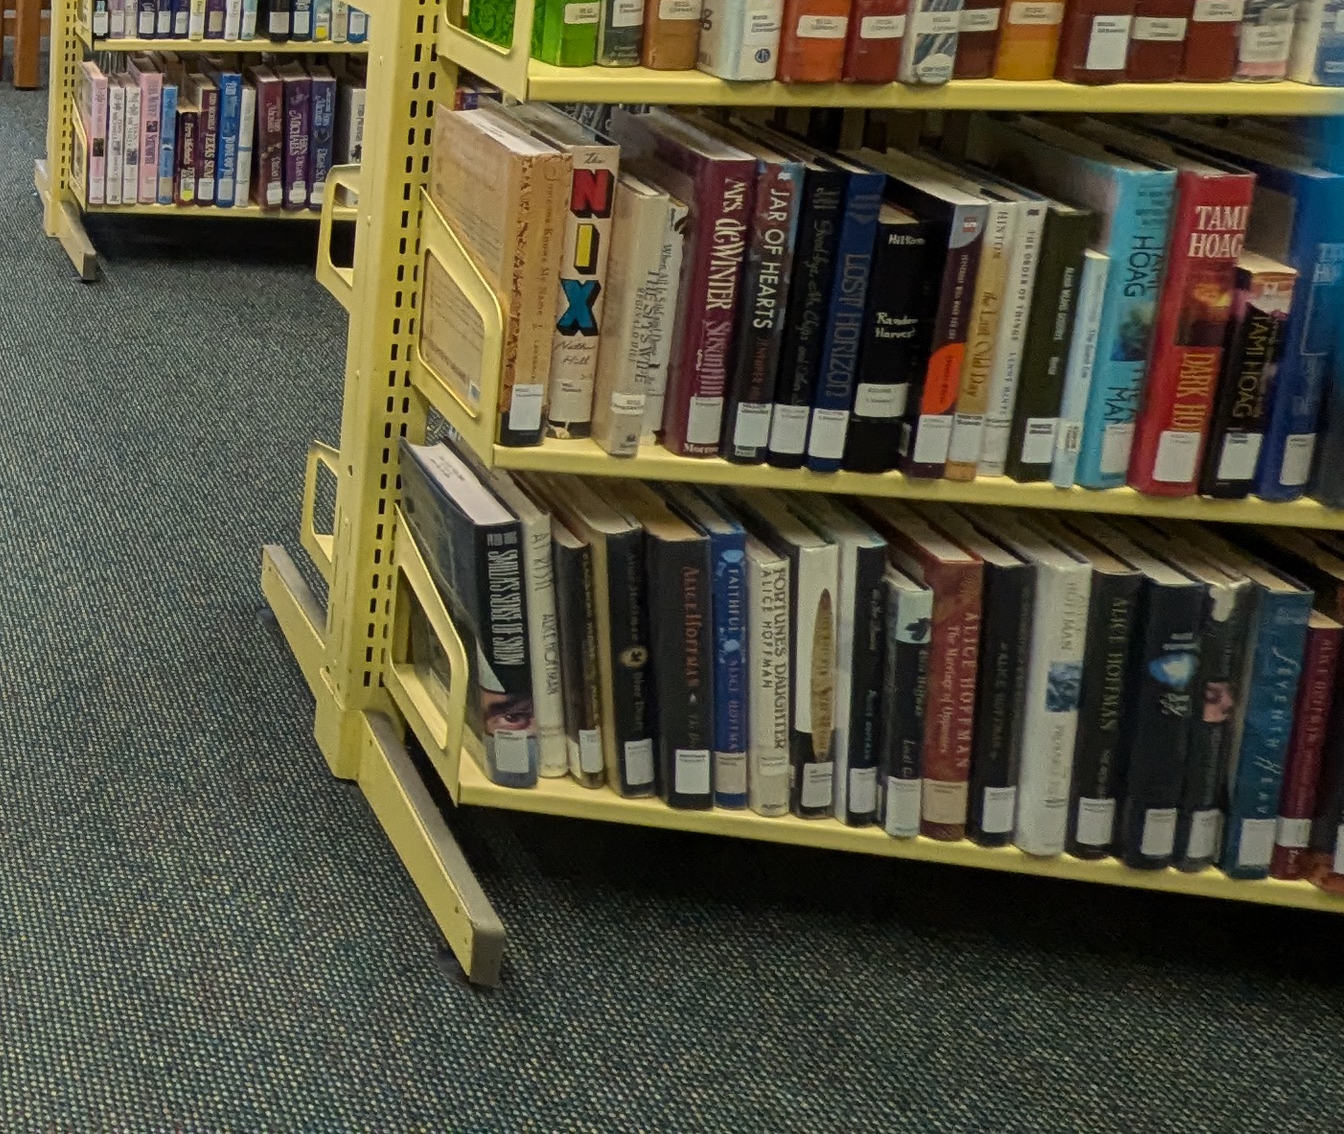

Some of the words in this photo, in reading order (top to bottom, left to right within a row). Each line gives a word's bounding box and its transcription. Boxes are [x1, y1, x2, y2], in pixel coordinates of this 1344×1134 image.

[584, 153, 604, 164] The
[767, 188, 790, 221] JAR
[1194, 206, 1248, 230] TAMI
[557, 169, 614, 337] NIX
[763, 229, 785, 256] OF
[888, 234, 925, 246] Hilton
[1188, 233, 1242, 257] HOAG
[839, 254, 870, 308] LOST
[1124, 236, 1154, 298] HOAG
[753, 262, 779, 328] HEARTS
[875, 313, 918, 326] Random
[1245, 316, 1270, 355] TAMI
[563, 356, 590, 365] Hill
[826, 312, 860, 398] HORIZON
[1175, 353, 1214, 398] DARK
[1232, 372, 1260, 418] HOAG
[727, 569, 741, 632] FAITHFUL
[761, 570, 773, 613] ALICE
[761, 620, 773, 689] HOFFMAN
[962, 612, 980, 669] ALICE
[774, 660, 787, 749] DAUGHTER
[956, 674, 977, 768] HOFFMAN
